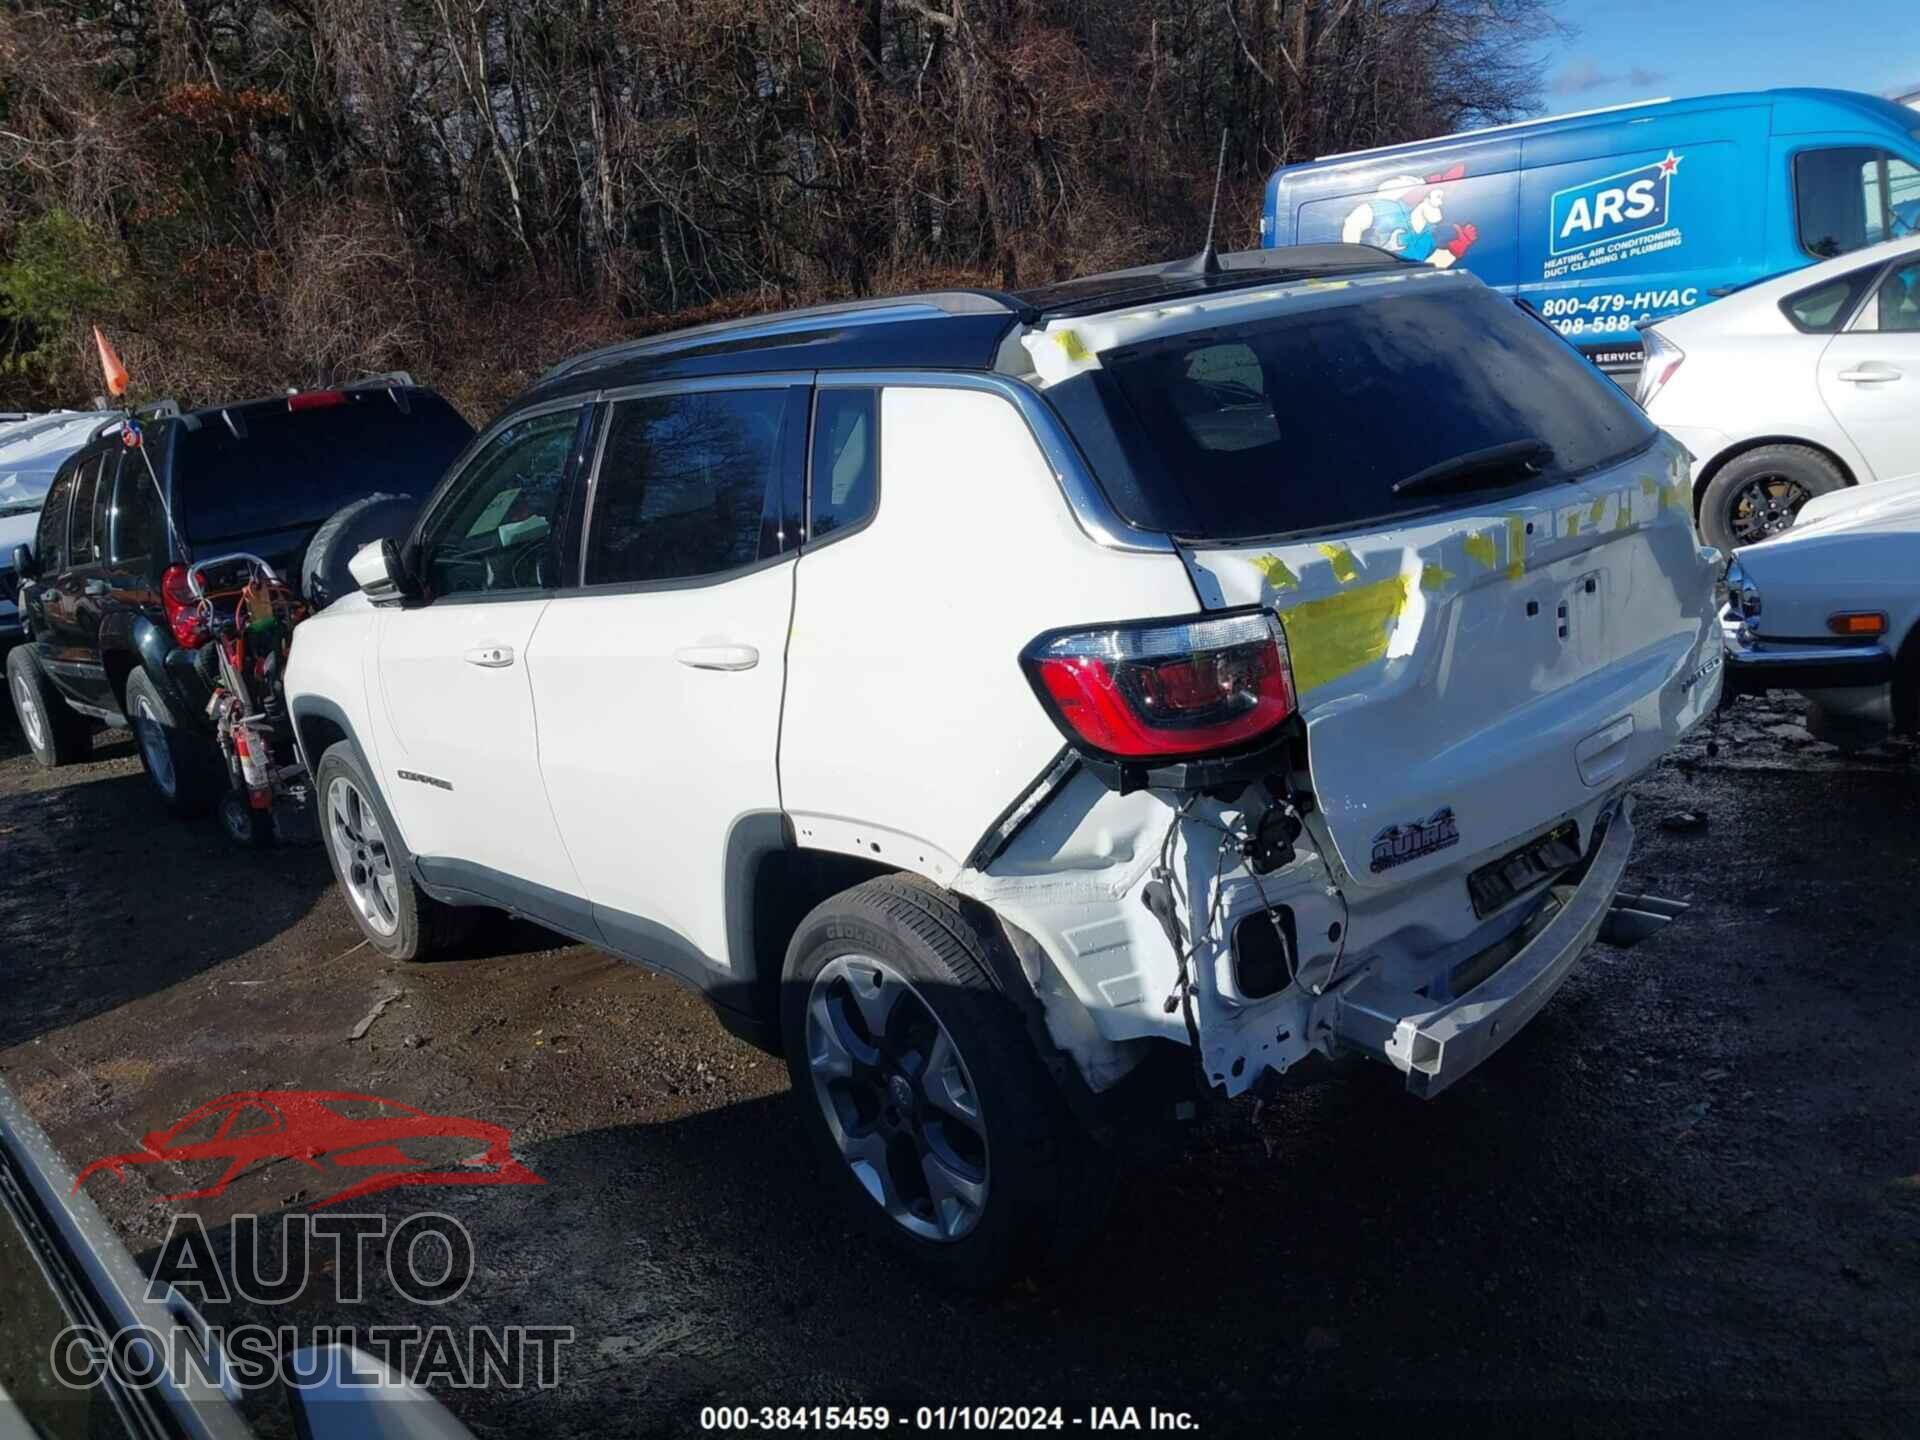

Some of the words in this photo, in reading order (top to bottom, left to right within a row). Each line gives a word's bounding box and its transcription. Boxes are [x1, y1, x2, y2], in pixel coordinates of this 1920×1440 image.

[1560, 179, 1655, 239] ARS
[1543, 265, 1569, 280] DUCT
[1570, 253, 1619, 272] CLEANING
[1620, 250, 1628, 260] &
[1629, 236, 1682, 258] PLUMBING
[1588, 246, 1606, 258] AIR
[1543, 287, 1698, 317] 800-479-HVAC
